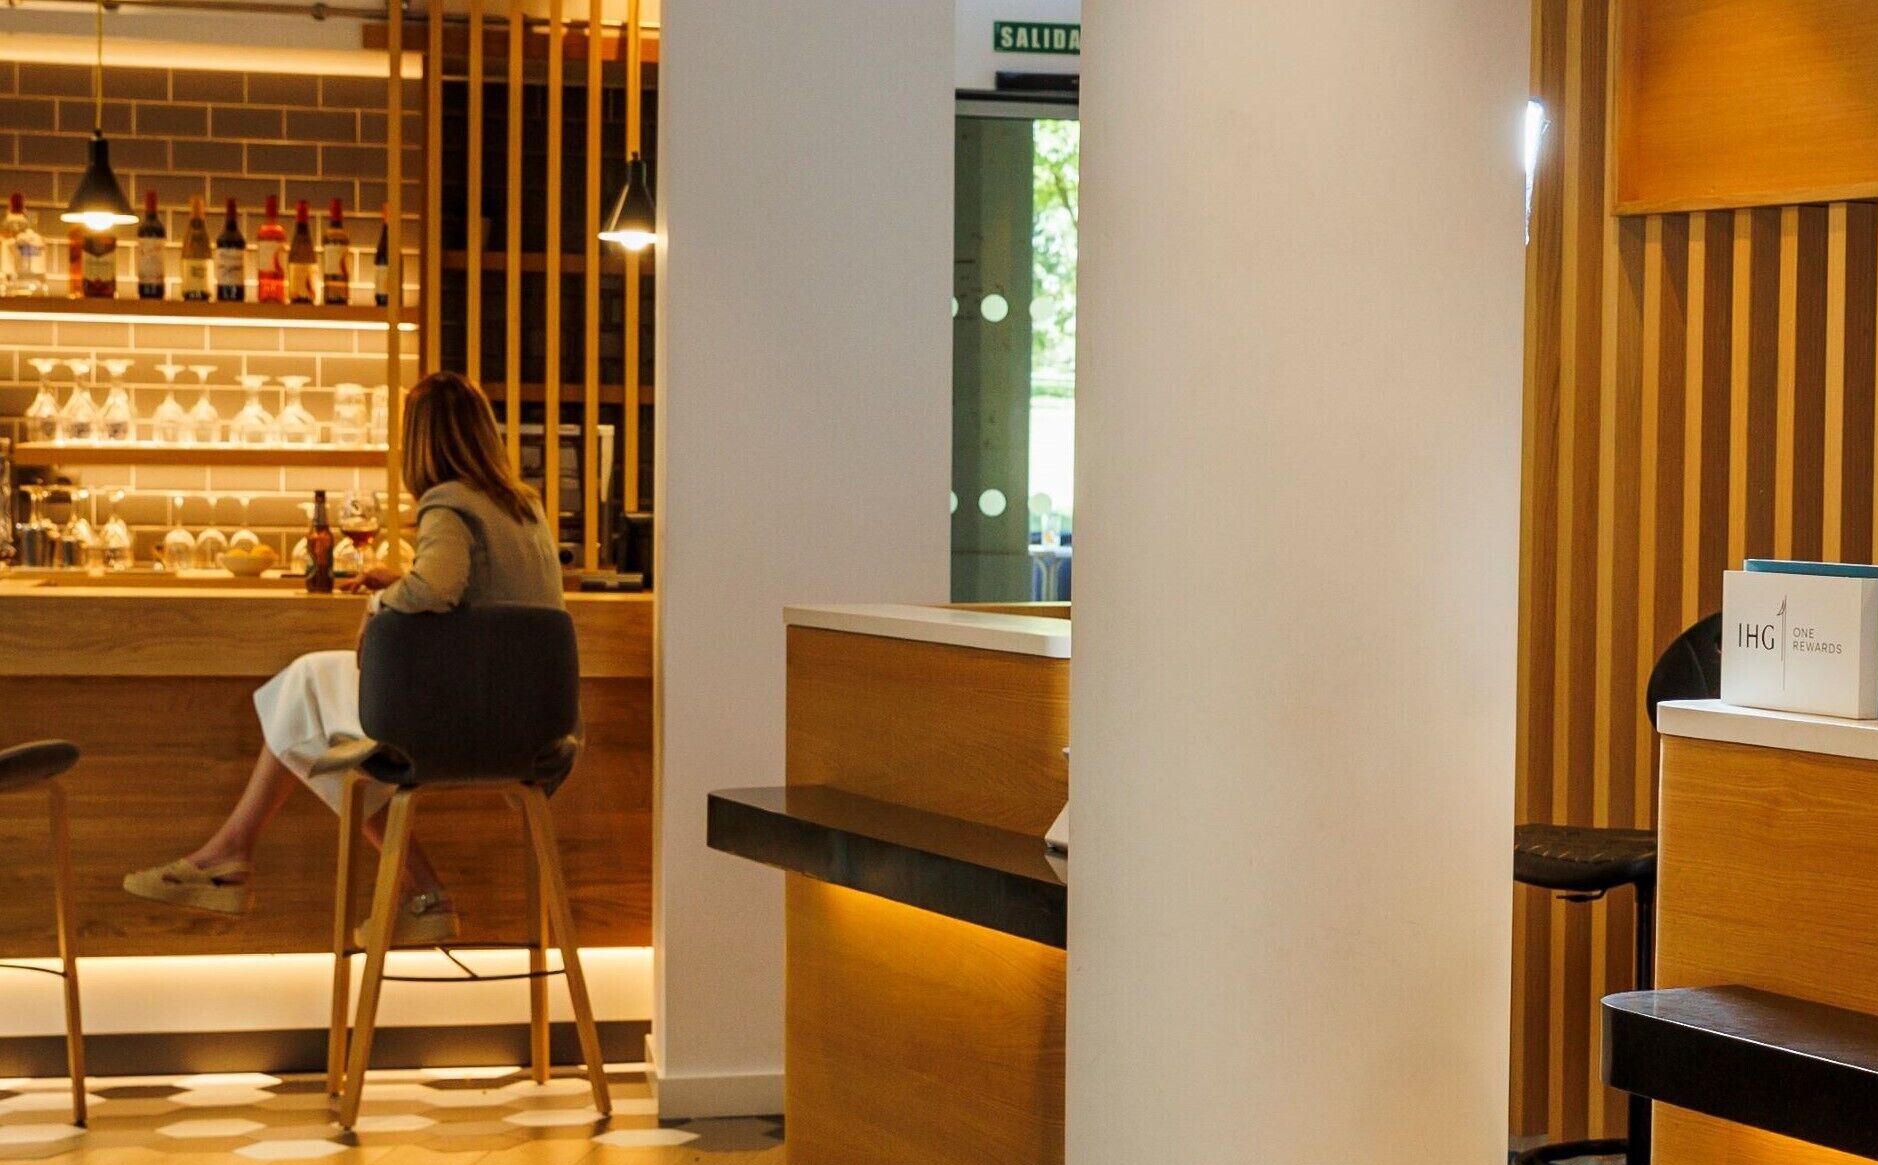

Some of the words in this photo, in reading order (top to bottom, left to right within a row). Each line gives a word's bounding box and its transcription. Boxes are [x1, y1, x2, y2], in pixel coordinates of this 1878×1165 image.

[1000, 26, 1080, 50] SALIDA
[1738, 622, 1775, 651] IHG
[1792, 627, 1815, 639] ONE
[1792, 640, 1843, 655] REWARDS
